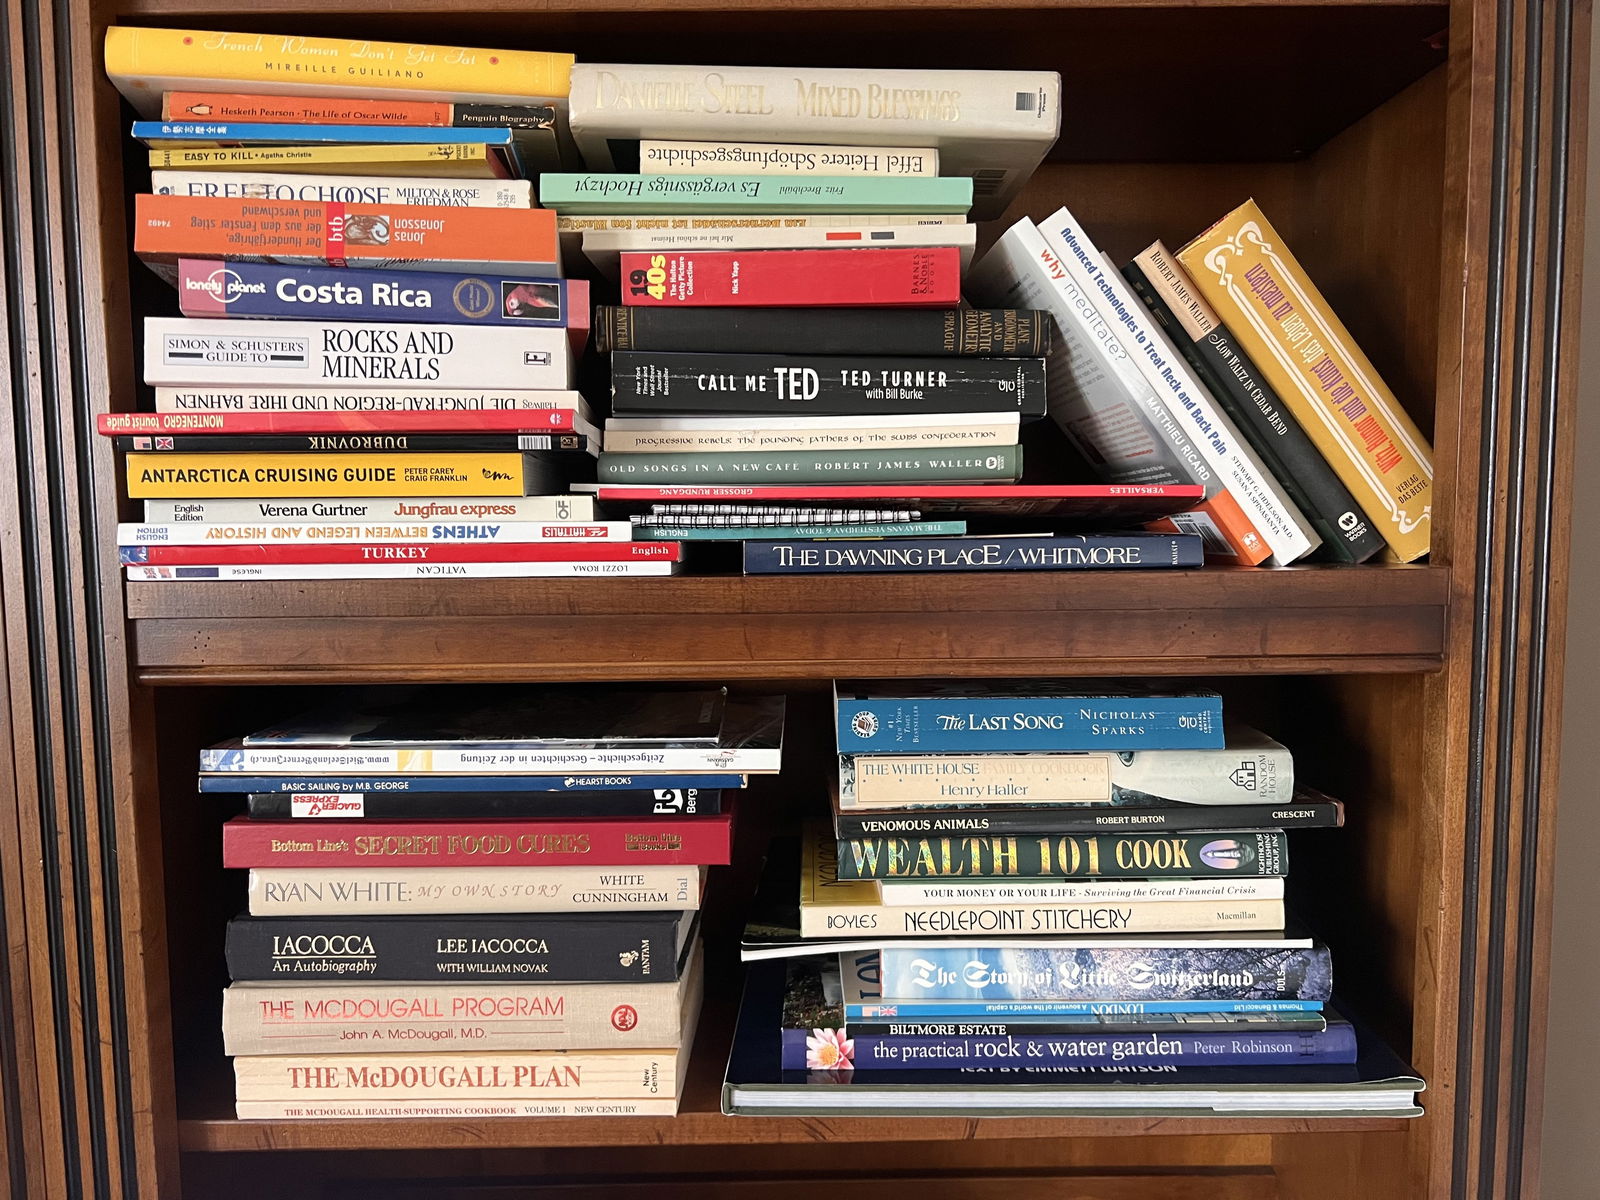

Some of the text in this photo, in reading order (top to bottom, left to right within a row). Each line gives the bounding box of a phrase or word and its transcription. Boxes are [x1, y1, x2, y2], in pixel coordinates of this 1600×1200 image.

[265, 62, 424, 79] MIREILLE GUILIANO
[221, 106, 408, 121] Hesketh Pearson The Life of Oscar Wilde
[462, 114, 545, 125] Penguin Biography
[184, 151, 254, 161] EASY TO KILL
[260, 151, 312, 160] Agatha Christie
[647, 148, 923, 173] Effel Heitere Schöpfungsgeschichte
[575, 177, 761, 197] Es vergässnigs Hochzyt
[186, 277, 266, 295] lonely planet
[276, 278, 363, 305] Costa
[372, 283, 432, 308] Rica
[1040, 249, 1066, 280] why
[1064, 283, 1127, 362] meditate?
[168, 338, 305, 352] SIMON & SCHUSTER'S
[322, 328, 454, 355] ROCKS AND
[1061, 227, 1228, 456] Advanced Technologies to Treat Neck and Back Pain
[206, 352, 268, 363] GUIDE TO
[322, 355, 440, 380] MINERALS
[698, 367, 820, 400] CALL ME TED
[841, 370, 947, 388] TED TURNER
[866, 388, 923, 400] with Bill Burke
[1146, 397, 1182, 446] MATTHIEU
[1181, 443, 1210, 481] RICARD
[404, 467, 455, 475] PETER CAREY
[609, 462, 800, 473] OLD SONGS IN A NEW CAFÉ
[814, 459, 982, 470] ROBERT JAMES WALLER
[141, 467, 396, 483] ANTARCTICA CRUISING GUIDE
[429, 474, 468, 482] FRANKLIN
[259, 503, 368, 517] Verena Gurtner
[394, 502, 517, 520] Jungfrau express
[205, 525, 501, 539] ATHENS BETWEEN LEGEND AND HISTORY
[363, 546, 430, 559] TURKEY
[772, 546, 820, 567] THE
[825, 549, 922, 566] DAWNING
[928, 545, 1002, 566] PLACE
[1018, 547, 1141, 565] WHITMORE
[936, 712, 1064, 731] The LAST SONG
[1079, 708, 1156, 720] NICHOLAS
[1091, 723, 1146, 735] SPARKS
[862, 763, 980, 775] THE WHITE HOUSE
[281, 781, 409, 792] BASIC SAILING by M.B. GEORGE
[941, 783, 1029, 798] Henry Haller
[1096, 815, 1165, 825] ROBERT BURTON
[1272, 810, 1315, 819] CRESCENT
[861, 818, 989, 832] VENOMOUS ANIMALS
[850, 836, 1192, 877] WEALTH 101 COOK
[599, 875, 644, 886] WHITE
[265, 881, 412, 902] RYAN WHITE:
[572, 892, 668, 904] CUNNINGHAM
[827, 908, 1132, 932] BOYLES NEEDLEPOINT STITCHERY
[1216, 911, 1257, 921] Macmillan
[272, 935, 375, 956] IACOCCA
[436, 938, 549, 954] LEE IACOCCA
[272, 959, 377, 974] An Autobiography
[436, 962, 548, 973] WITH WILLIAM NOVAK
[259, 996, 564, 1019] THE MCDOUGALL PROGRAM
[340, 1028, 487, 1041] John A. McDougall, M.D.
[889, 1024, 1007, 1035] BILTMORE ESTATE
[874, 1033, 1183, 1062] the practical rock & water garden
[1193, 1039, 1293, 1055] Peter Robinson
[287, 1065, 581, 1089] THE McDOUGALL PLAN
